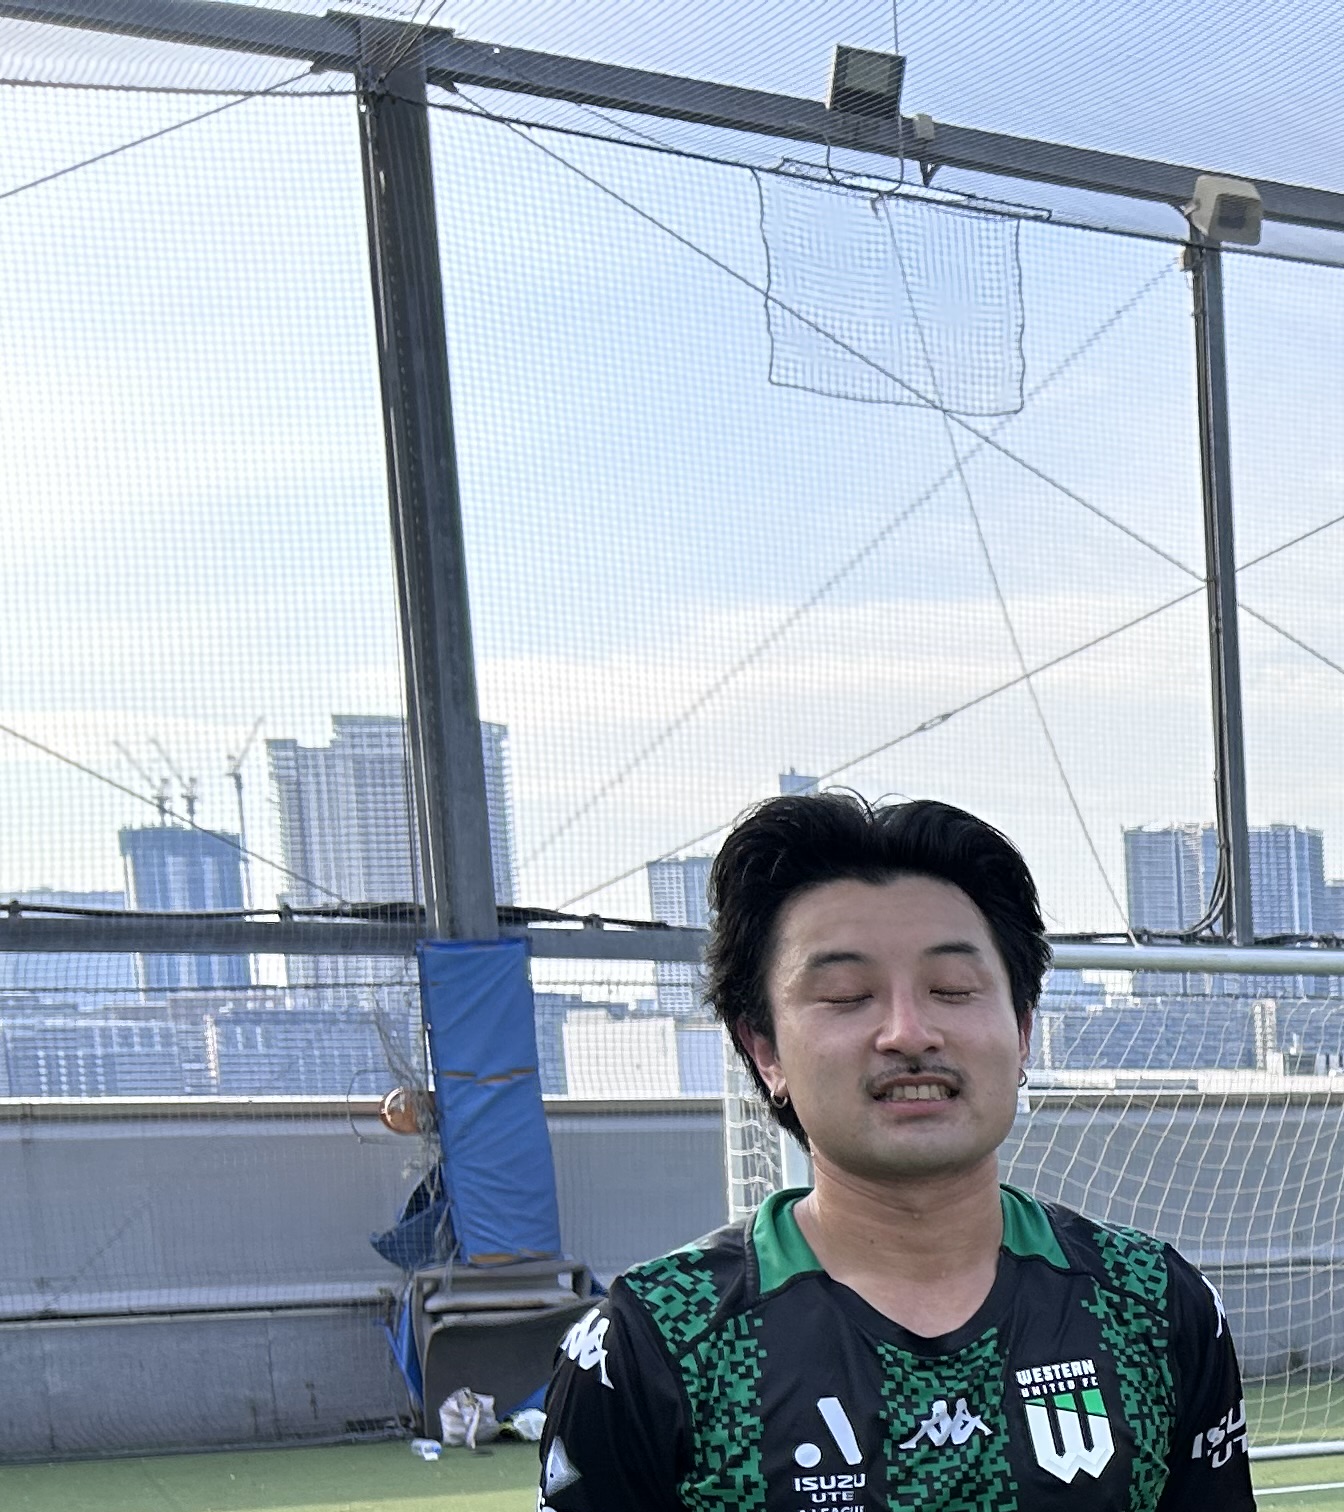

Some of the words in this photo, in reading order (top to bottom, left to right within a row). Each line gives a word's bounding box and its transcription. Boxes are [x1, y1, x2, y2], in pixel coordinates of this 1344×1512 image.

[1015, 1359, 1096, 1386] WESTERN
[1020, 1379, 1076, 1398] UNITED
[1081, 1376, 1099, 1388] FC
[794, 1473, 866, 1492] ISUZU
[811, 1491, 855, 1503] UTE
